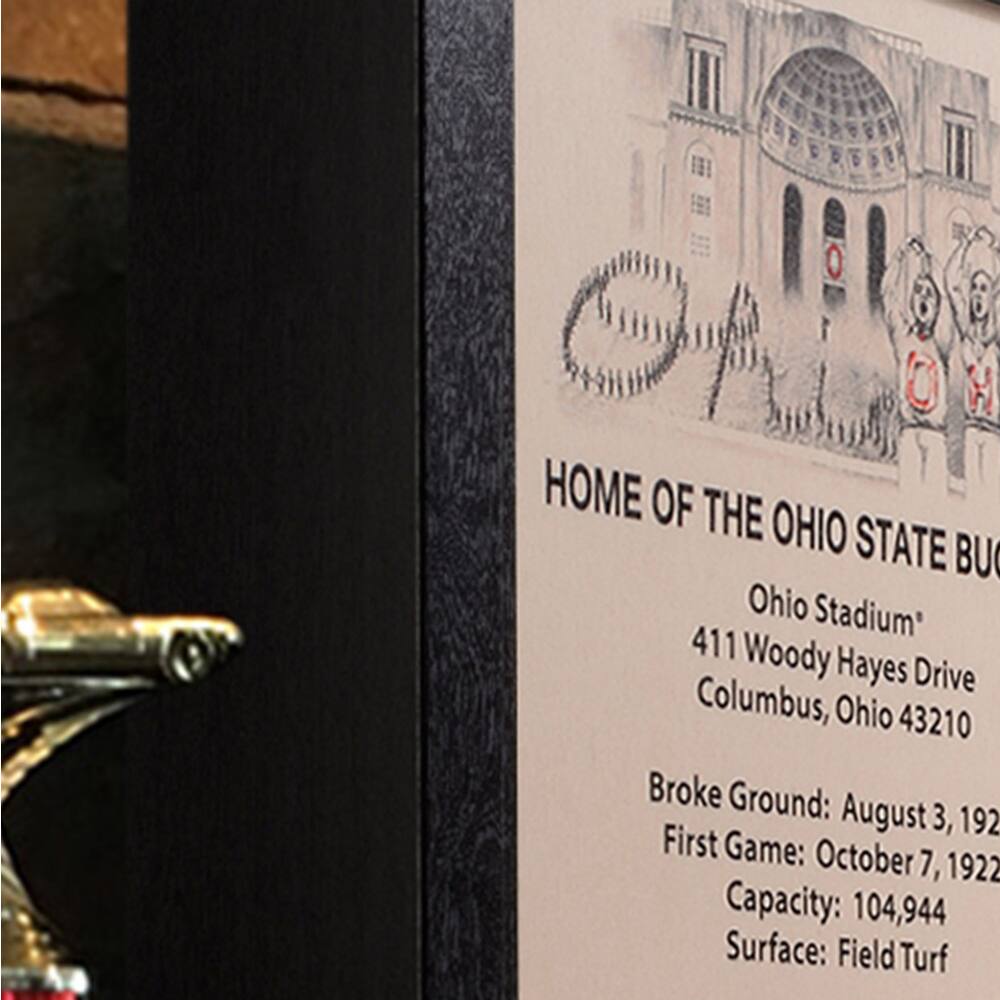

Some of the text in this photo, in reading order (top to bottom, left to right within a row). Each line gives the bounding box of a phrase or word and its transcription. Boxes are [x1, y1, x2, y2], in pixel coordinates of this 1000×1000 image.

[545, 457, 643, 521] HOME
[651, 477, 695, 528] OF
[703, 487, 764, 542] THE
[772, 499, 848, 556] OHIO
[855, 514, 947, 572] STATE
[748, 582, 809, 621] Ohio
[691, 625, 976, 693] 411 Woody Hayes Drive
[696, 675, 972, 740] Columbus, Ohio 43210
[648, 770, 723, 810] Broke
[728, 779, 830, 820] Ground:
[841, 791, 927, 834] August
[932, 801, 953, 836] 3,
[663, 822, 719, 860] First
[724, 829, 805, 867] Game:
[815, 837, 914, 876] October
[919, 848, 941, 883] 7,
[726, 879, 947, 928] Capacity: 104,944
[726, 929, 949, 974] Surface: Field Turf
